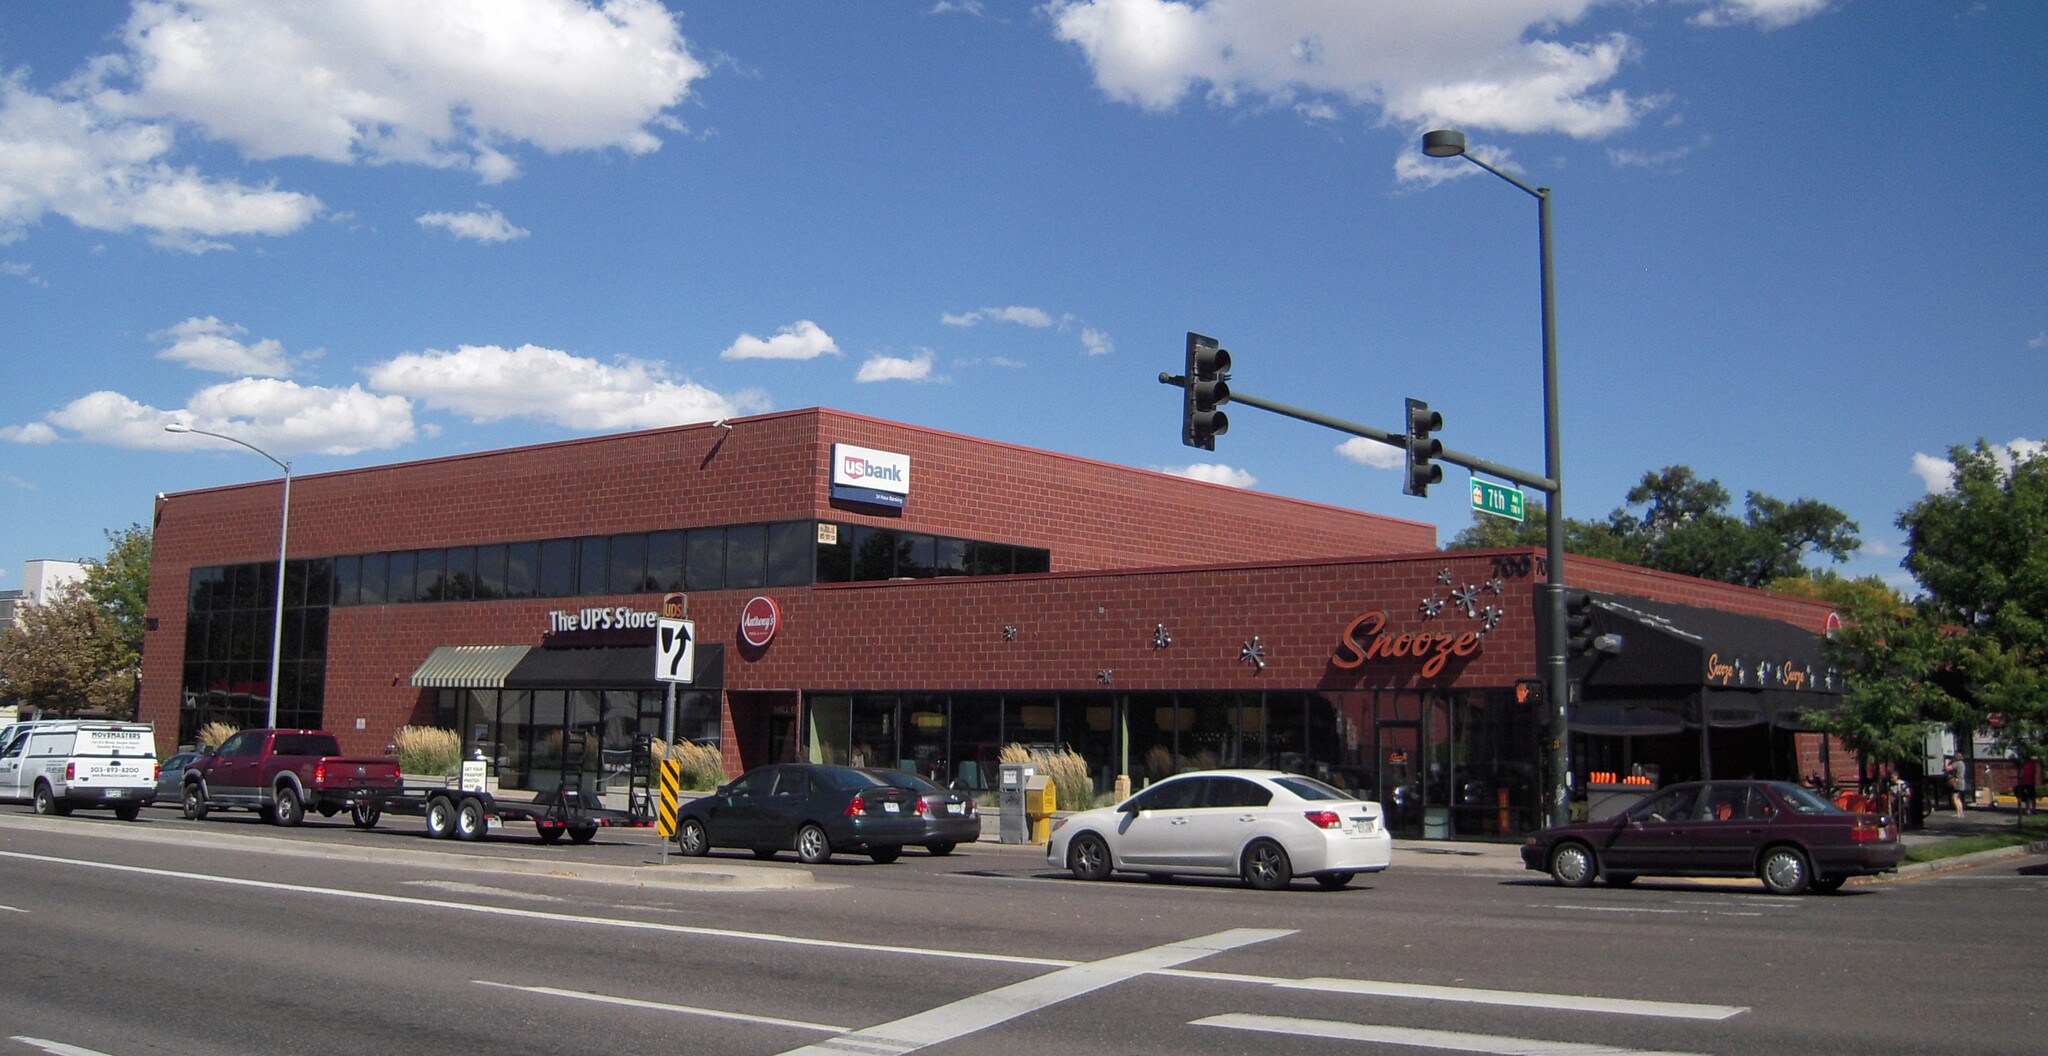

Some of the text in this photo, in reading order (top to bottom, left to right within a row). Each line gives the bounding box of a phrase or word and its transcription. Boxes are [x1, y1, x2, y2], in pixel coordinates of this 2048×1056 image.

[1488, 488, 1505, 511] 7th
[549, 606, 657, 632] The UPS Store
[1332, 610, 1479, 678] Snooze
[91, 732, 141, 740] MOVEMASTERS
